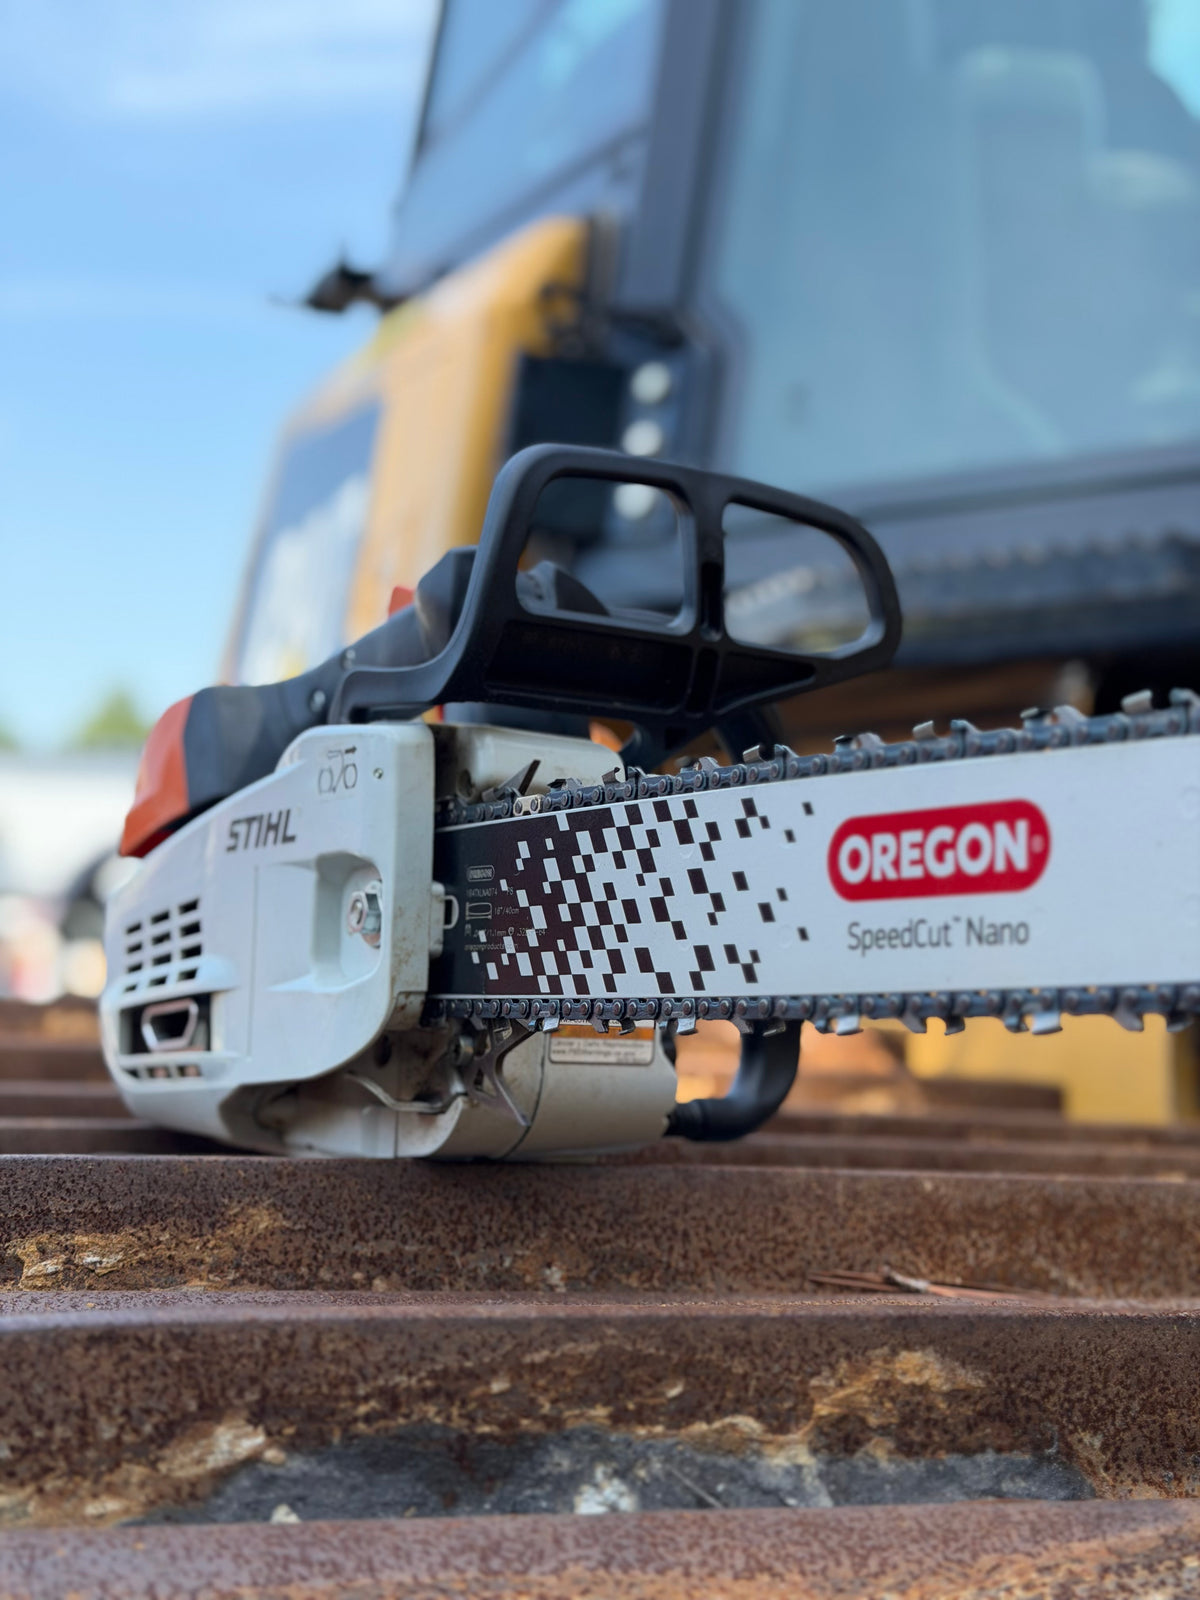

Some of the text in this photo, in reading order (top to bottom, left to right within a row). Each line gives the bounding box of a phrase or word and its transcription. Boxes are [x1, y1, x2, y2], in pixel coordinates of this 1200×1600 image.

[226, 809, 296, 852] STIHL
[838, 819, 1029, 885] OREGON
[965, 916, 1030, 948] Nano
